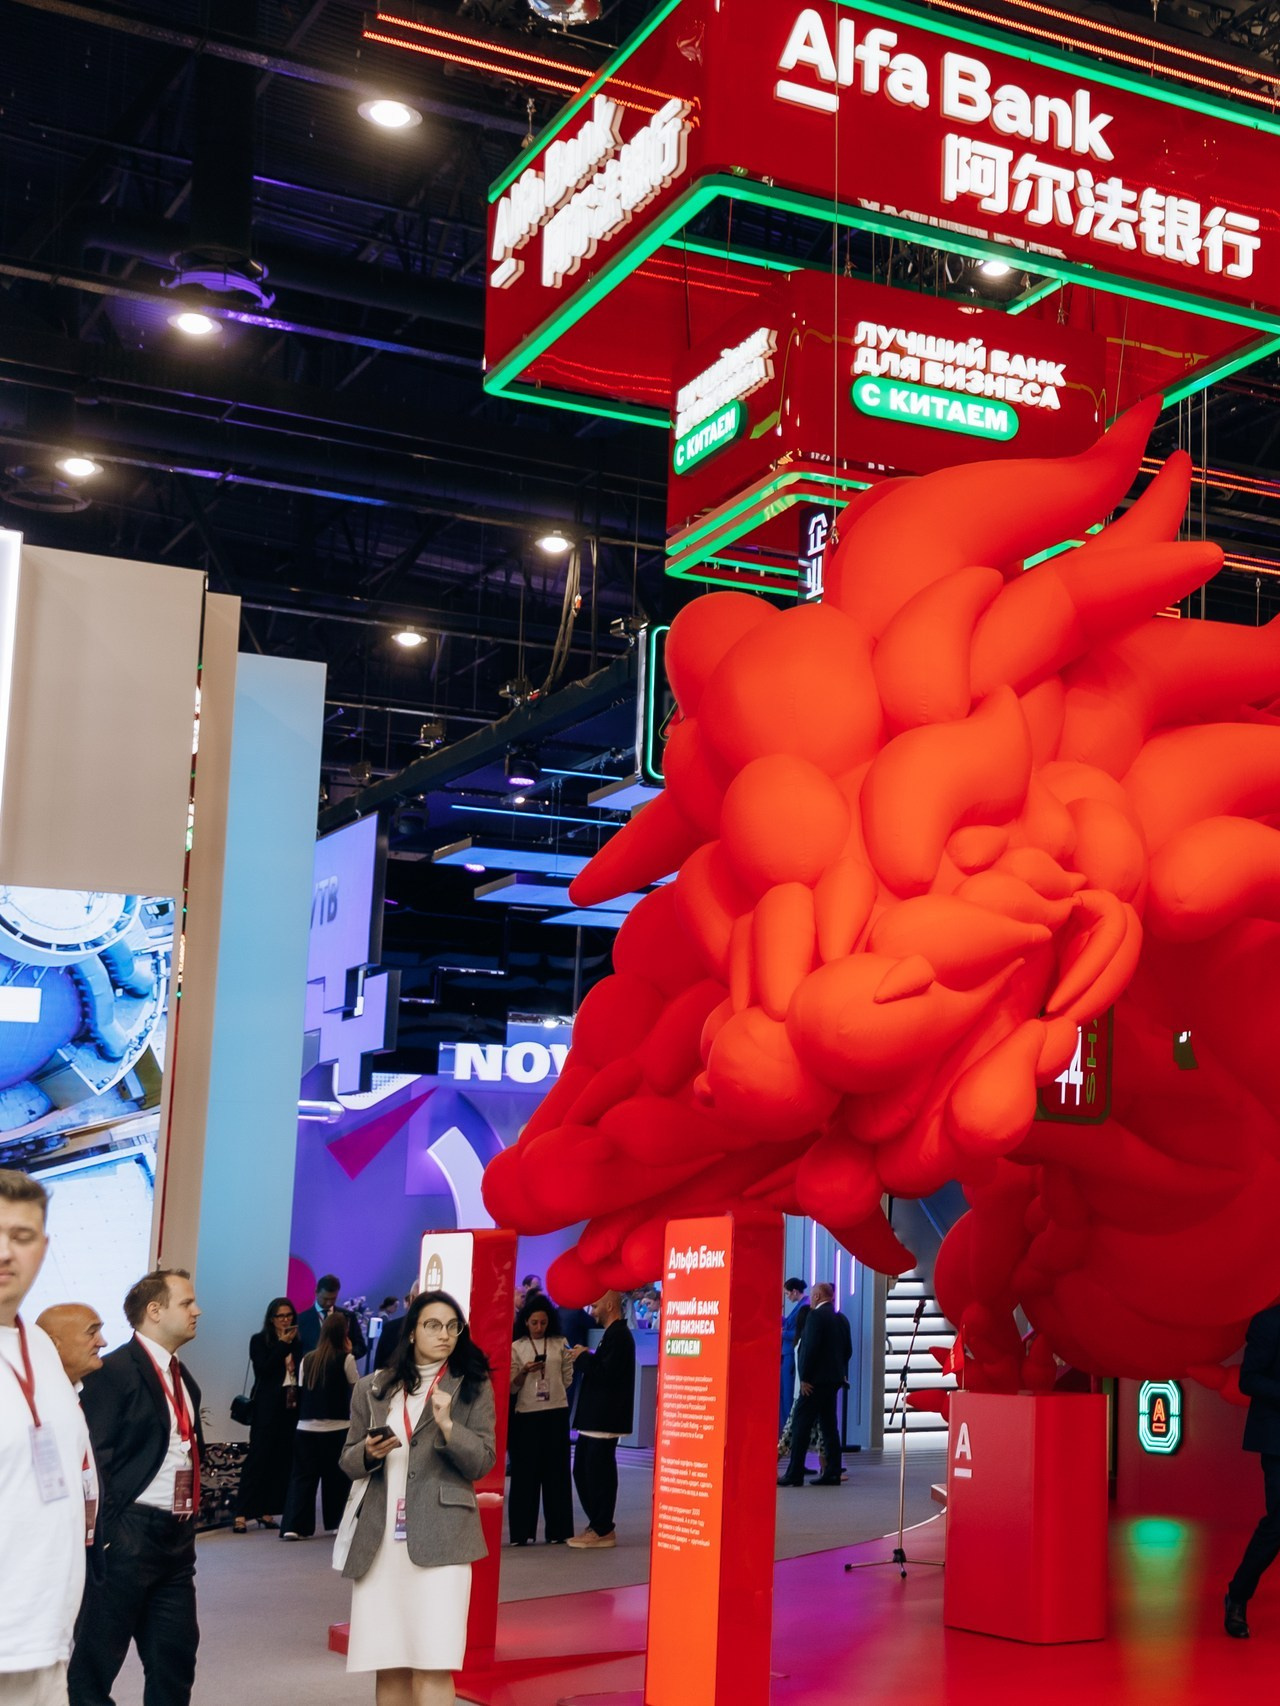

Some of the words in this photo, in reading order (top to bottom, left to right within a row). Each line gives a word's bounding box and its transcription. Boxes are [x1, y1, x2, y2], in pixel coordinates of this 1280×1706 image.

[778, 8, 930, 109] Alfa
[941, 52, 1115, 162] Bank
[942, 132, 1261, 279] 阿尔法银行
[854, 320, 987, 370] ЛУЧШИЙ
[989, 349, 1067, 387] БАНК
[853, 346, 921, 382] ДЛЯ
[923, 360, 1061, 410] БИЗНЕСА
[861, 382, 882, 407] С
[889, 387, 1009, 433] КИТАЕМ
[675, 443, 686, 467] С
[686, 407, 736, 460] КИТАЕМ
[668, 1246, 699, 1275] Альфа
[699, 1244, 726, 1269] Банк
[665, 1319, 681, 1336] ДЛЯ
[681, 1320, 715, 1334] БИЗНЕСА
[666, 1297, 697, 1316] ЛУЧШИЙ
[697, 1300, 719, 1315] БАНК
[665, 1340, 672, 1352] С
[672, 1340, 700, 1354] КИТАЕМ
[1153, 1398, 1166, 1422] A
[954, 1422, 973, 1461] A
